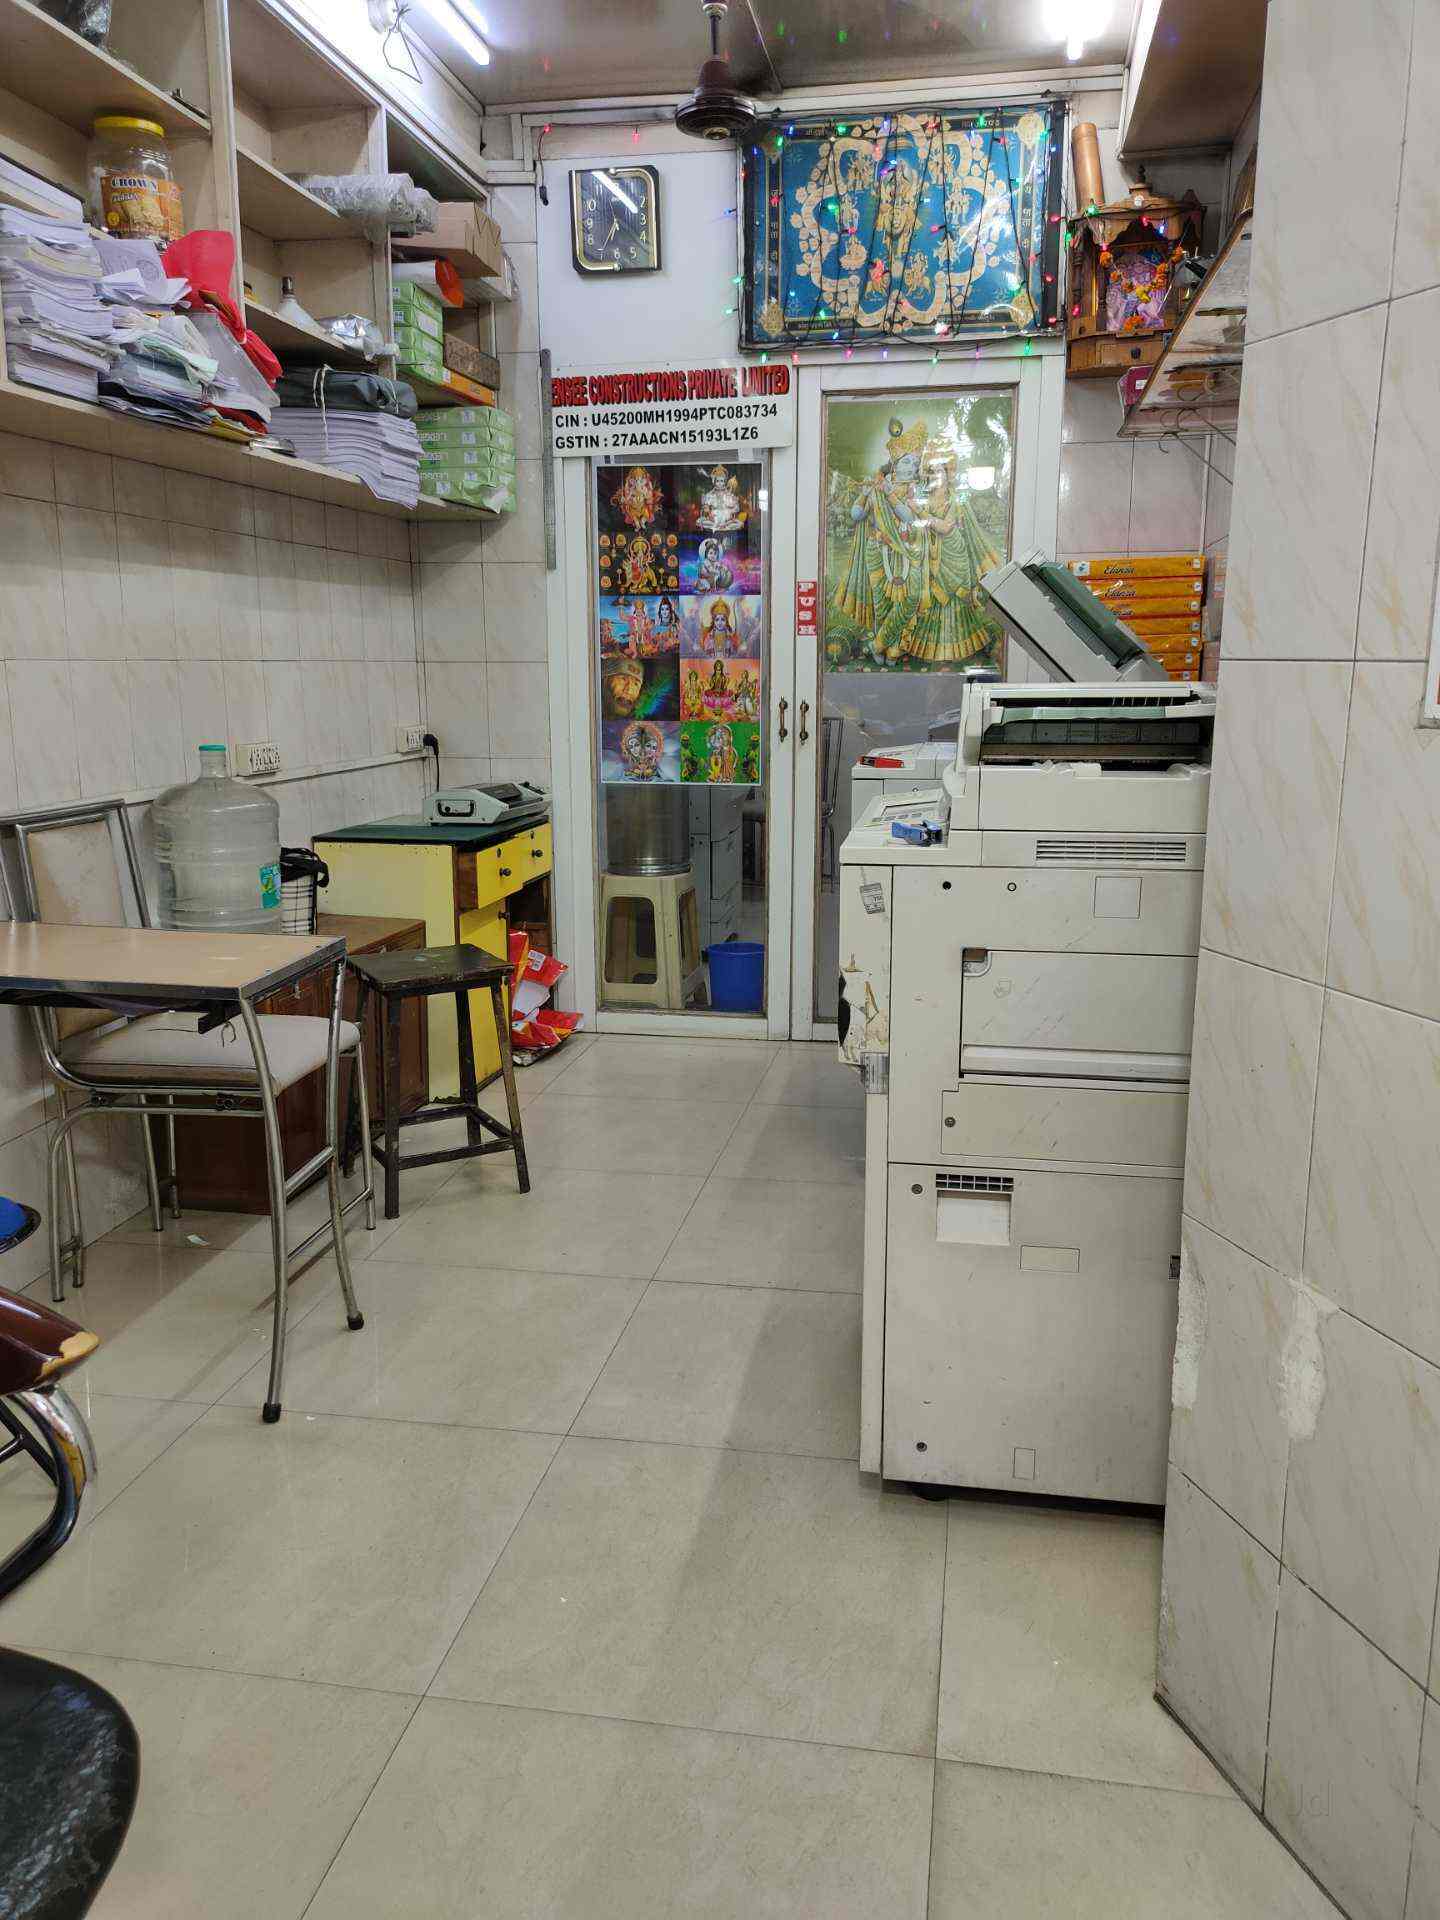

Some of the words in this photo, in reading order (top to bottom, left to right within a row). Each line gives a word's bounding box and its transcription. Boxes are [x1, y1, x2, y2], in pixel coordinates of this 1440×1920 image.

[639, 212, 647, 226] 3
[639, 230, 647, 246] 4
[629, 246, 637, 259] 5
[589, 371, 687, 405] CONSTRUCTIONS
[687, 368, 738, 400] PRIVATE
[555, 414, 580, 428] CIN
[591, 403, 778, 427] U45200MH1994PTC083734
[555, 434, 600, 449] GSTIN
[611, 426, 759, 447] 27AAACN15193L1Z6
